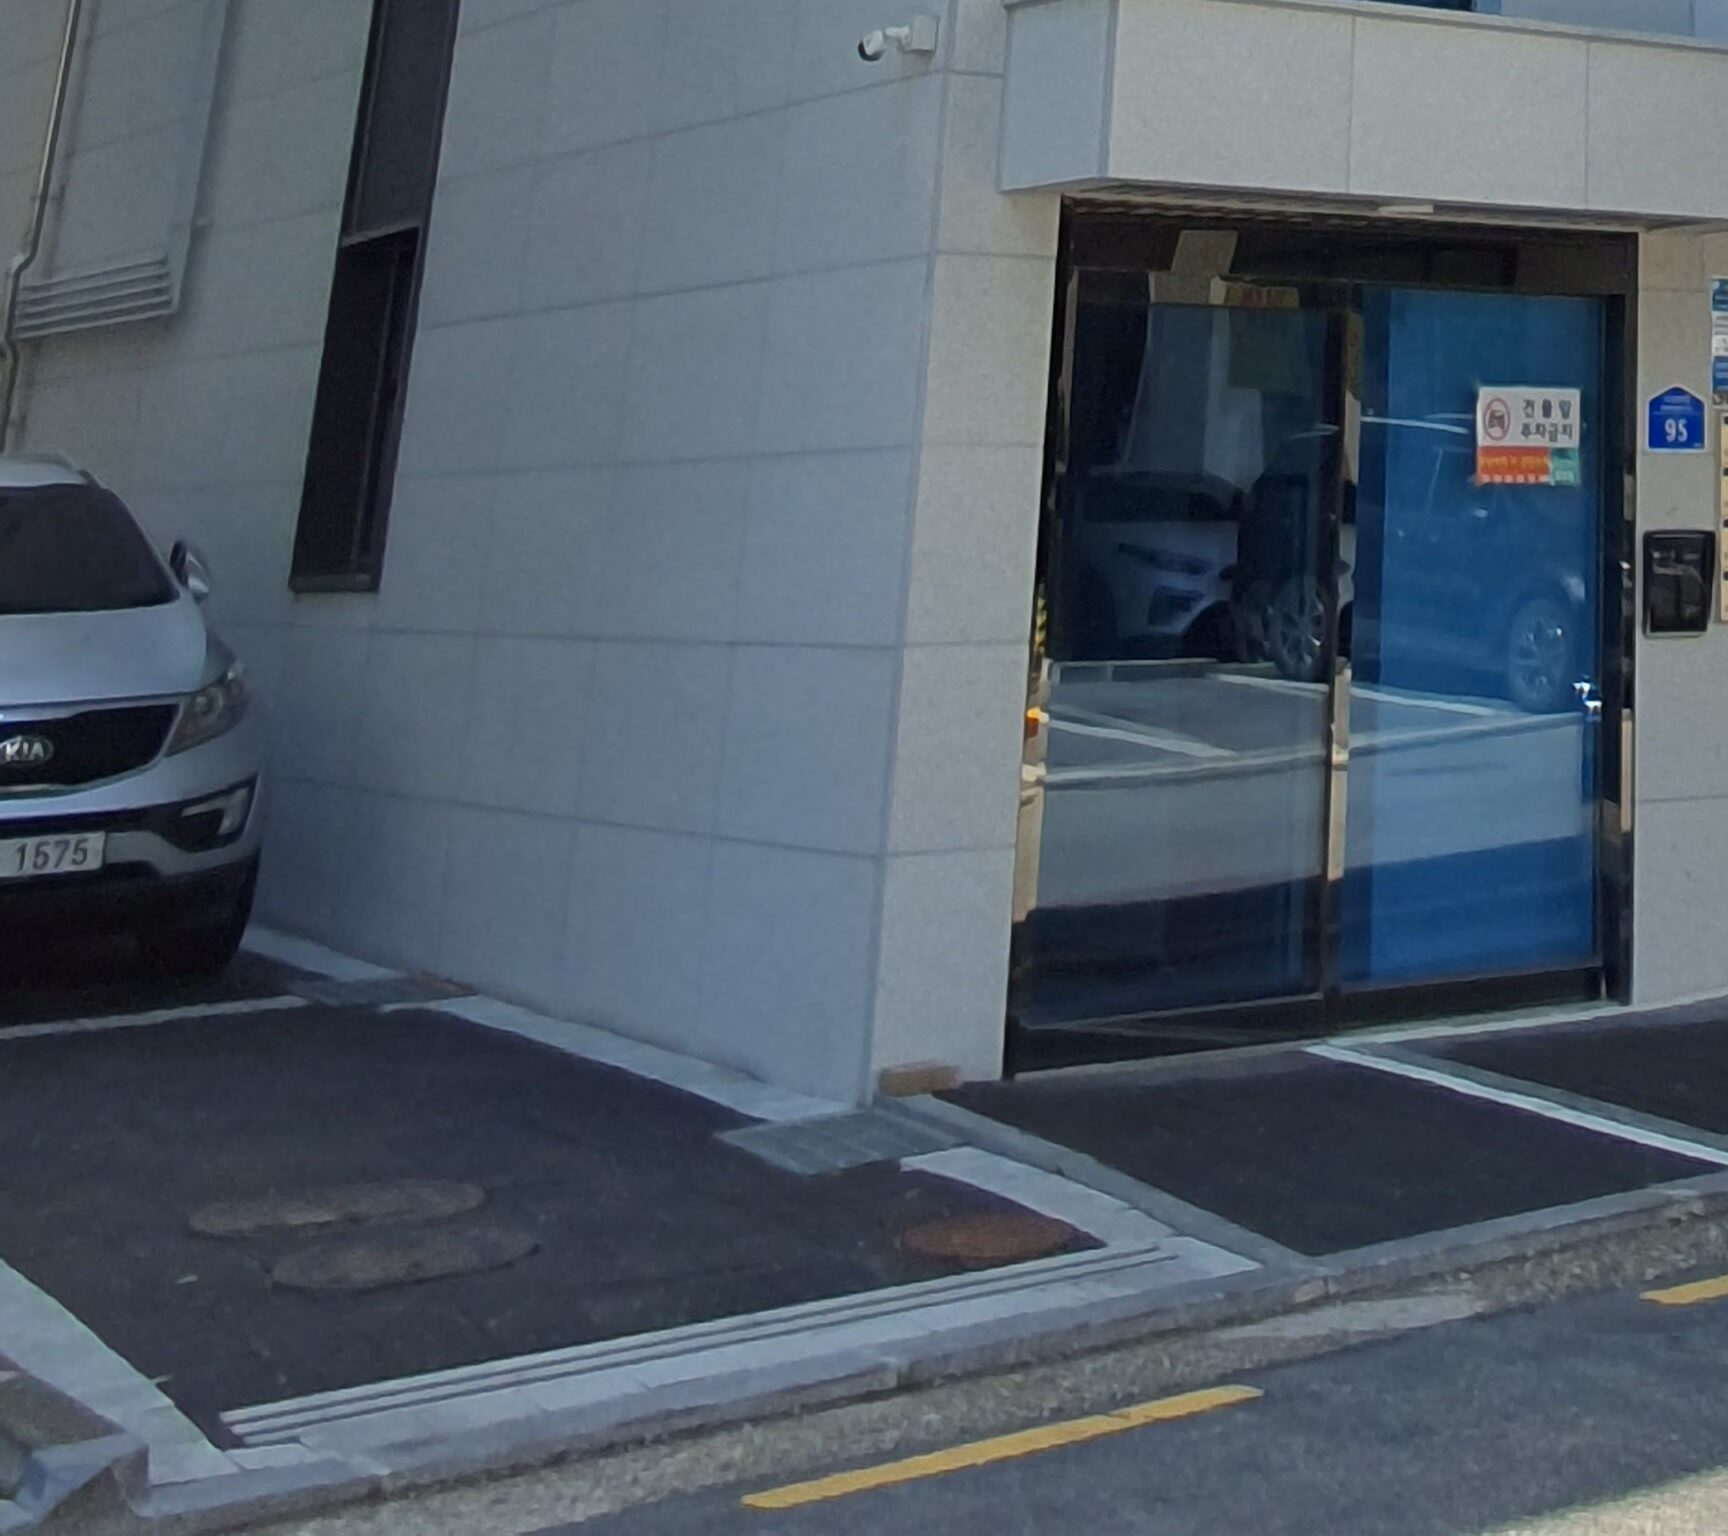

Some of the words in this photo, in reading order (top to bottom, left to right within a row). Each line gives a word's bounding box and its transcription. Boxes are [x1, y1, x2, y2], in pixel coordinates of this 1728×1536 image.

[1521, 422, 1573, 442] 주차금지
[1664, 418, 1688, 443] 95
[5, 738, 45, 762] KIA
